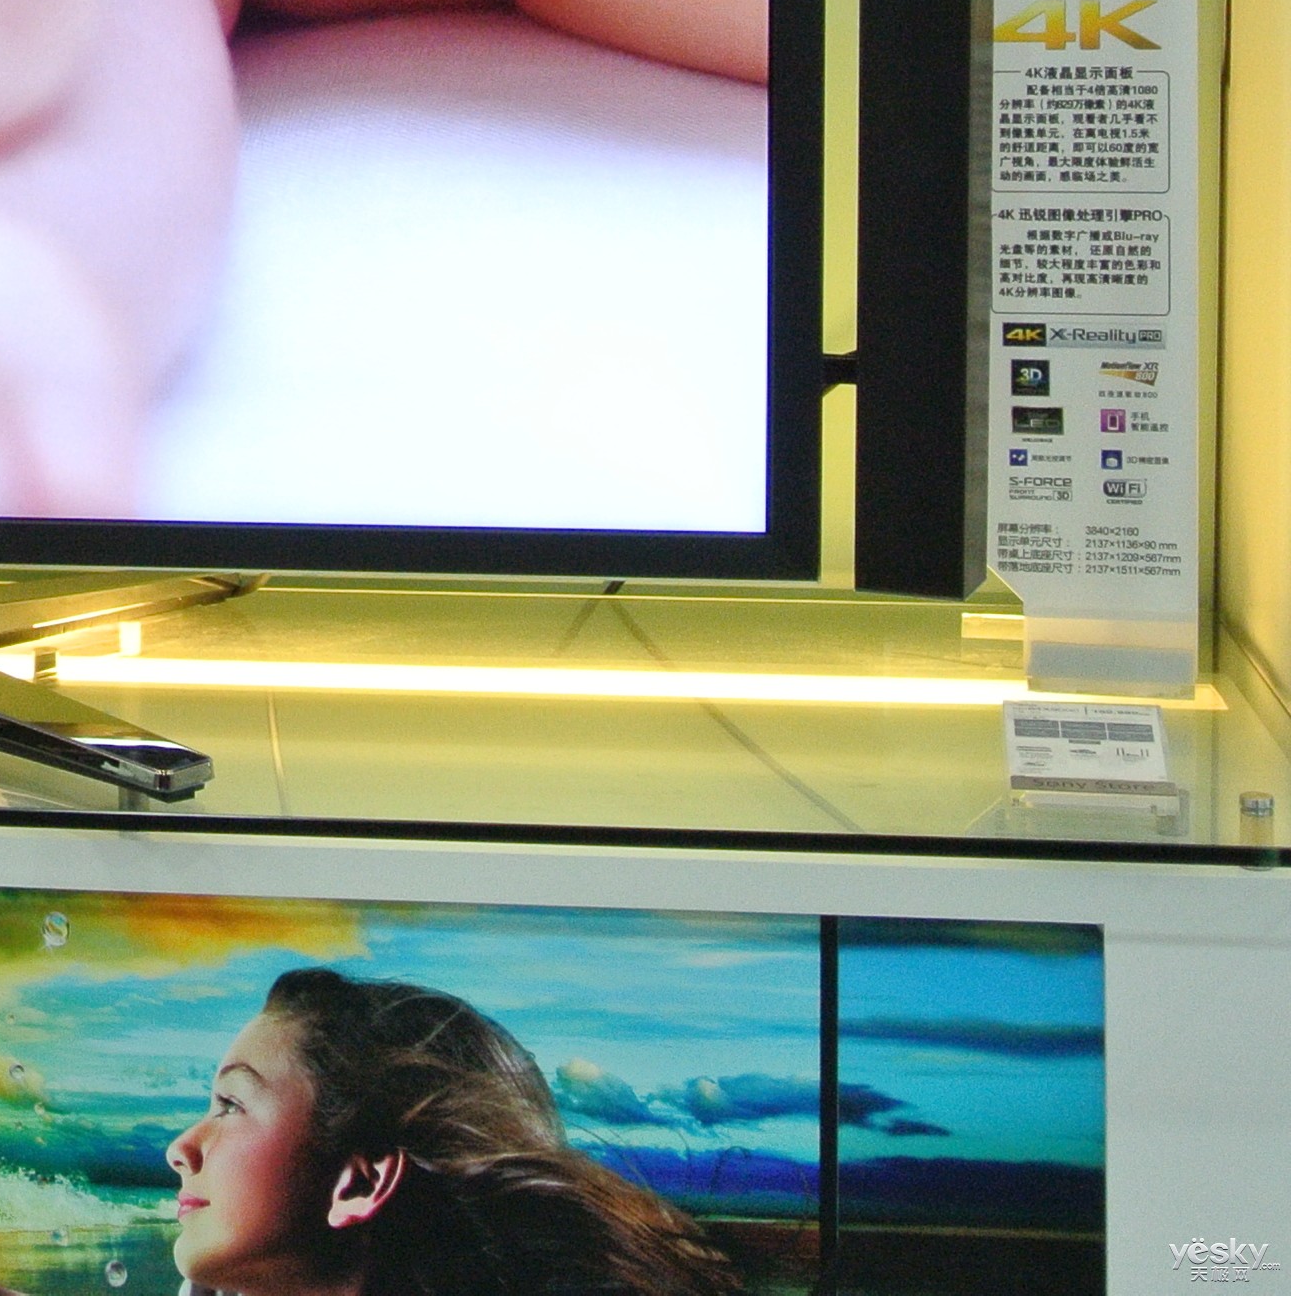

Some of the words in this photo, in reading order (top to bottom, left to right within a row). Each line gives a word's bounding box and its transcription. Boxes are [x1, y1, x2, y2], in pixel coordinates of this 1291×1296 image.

[993, 0, 1162, 51] 4K
[1025, 66, 1134, 80] 4K液晶显示面板
[1006, 328, 1043, 341] 4K
[1049, 327, 1137, 344] X-Reality
[1139, 330, 1162, 342] PRO
